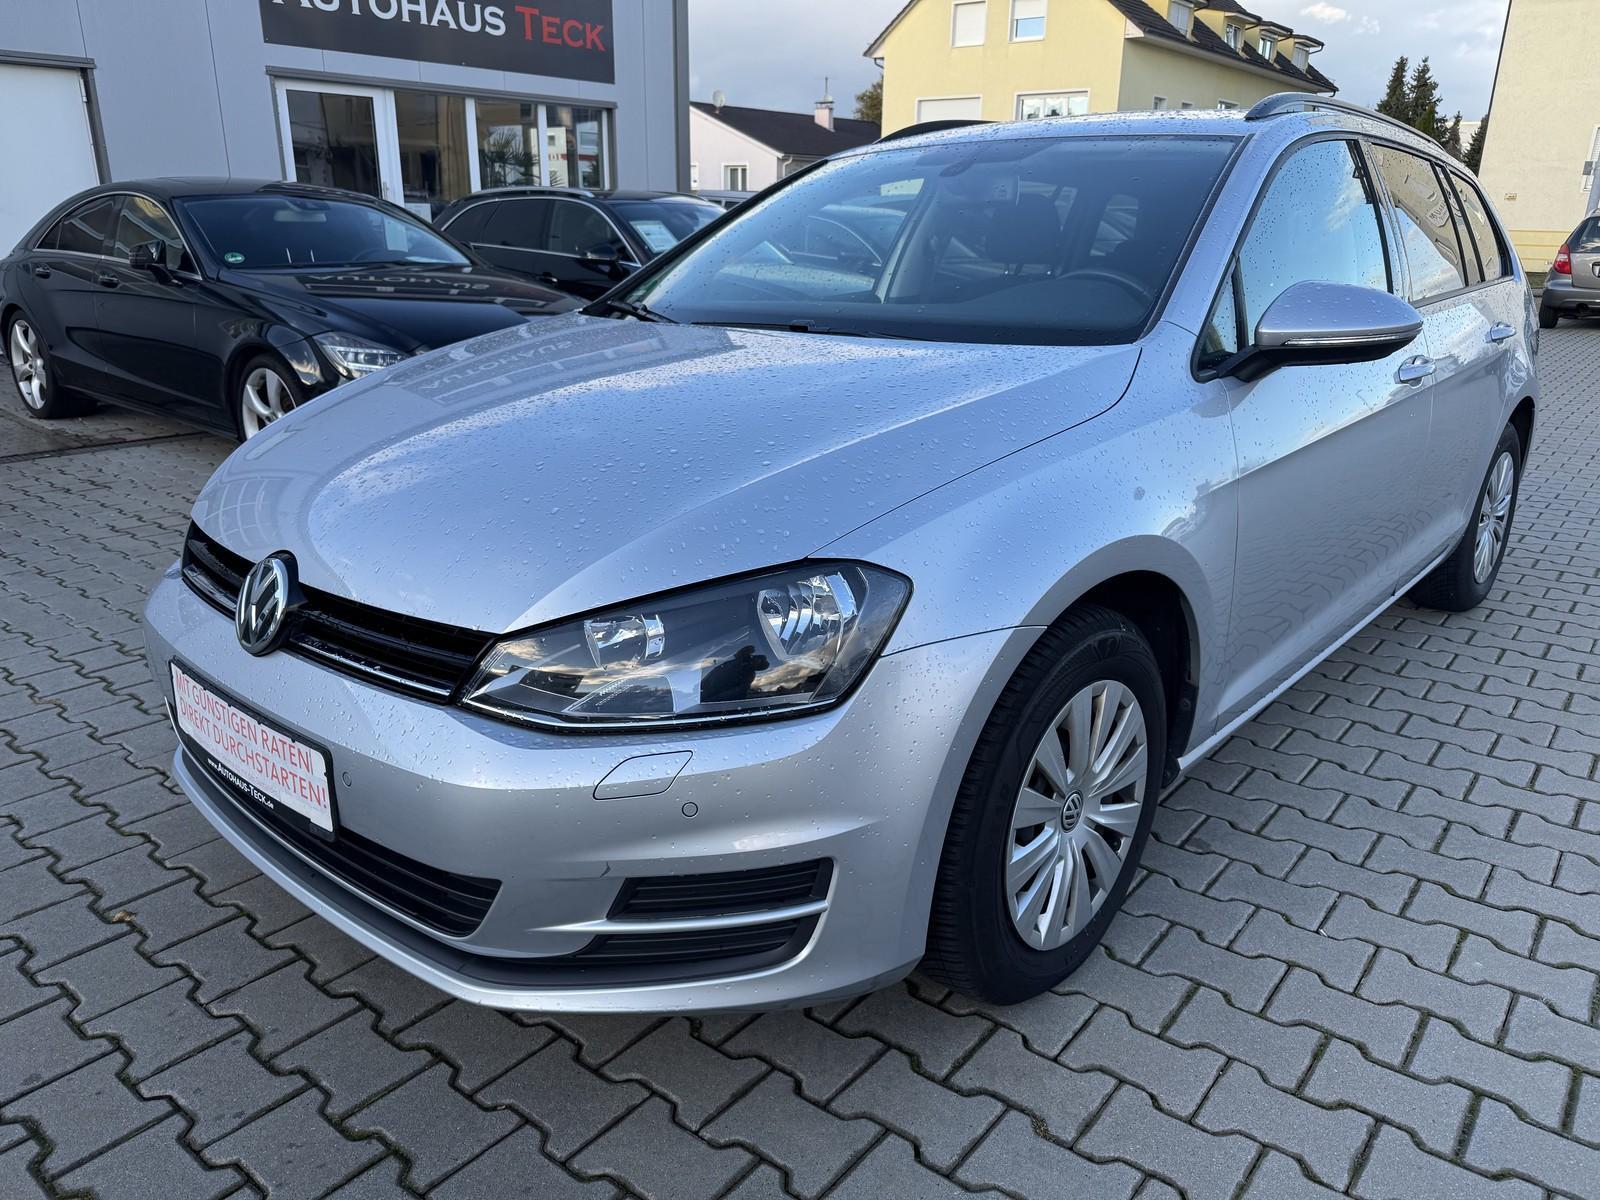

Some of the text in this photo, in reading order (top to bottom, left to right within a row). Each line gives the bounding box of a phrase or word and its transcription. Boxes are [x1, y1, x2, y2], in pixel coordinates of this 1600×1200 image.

[272, 0, 606, 51] OHAUS TECK
[175, 671, 311, 774] MIT GÜNSTIGEN RATEN
[180, 701, 327, 809] DIREKT DURCHSTARTEN!
